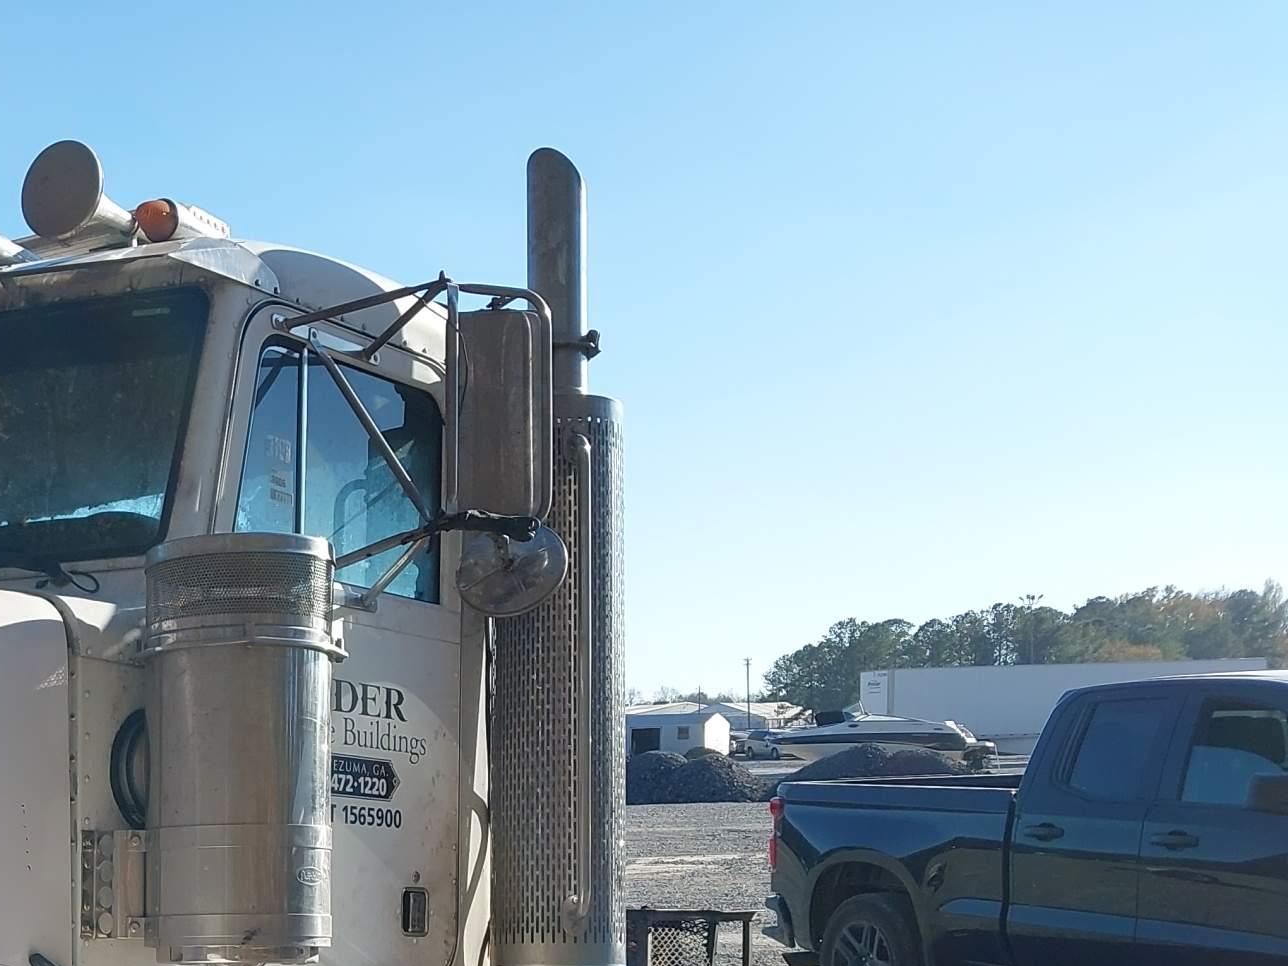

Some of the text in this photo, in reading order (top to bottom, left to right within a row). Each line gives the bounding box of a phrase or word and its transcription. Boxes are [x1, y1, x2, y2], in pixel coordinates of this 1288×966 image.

[344, 717, 426, 764] Buildings
[372, 764, 389, 776] GA.
[342, 805, 402, 828] 1565900
